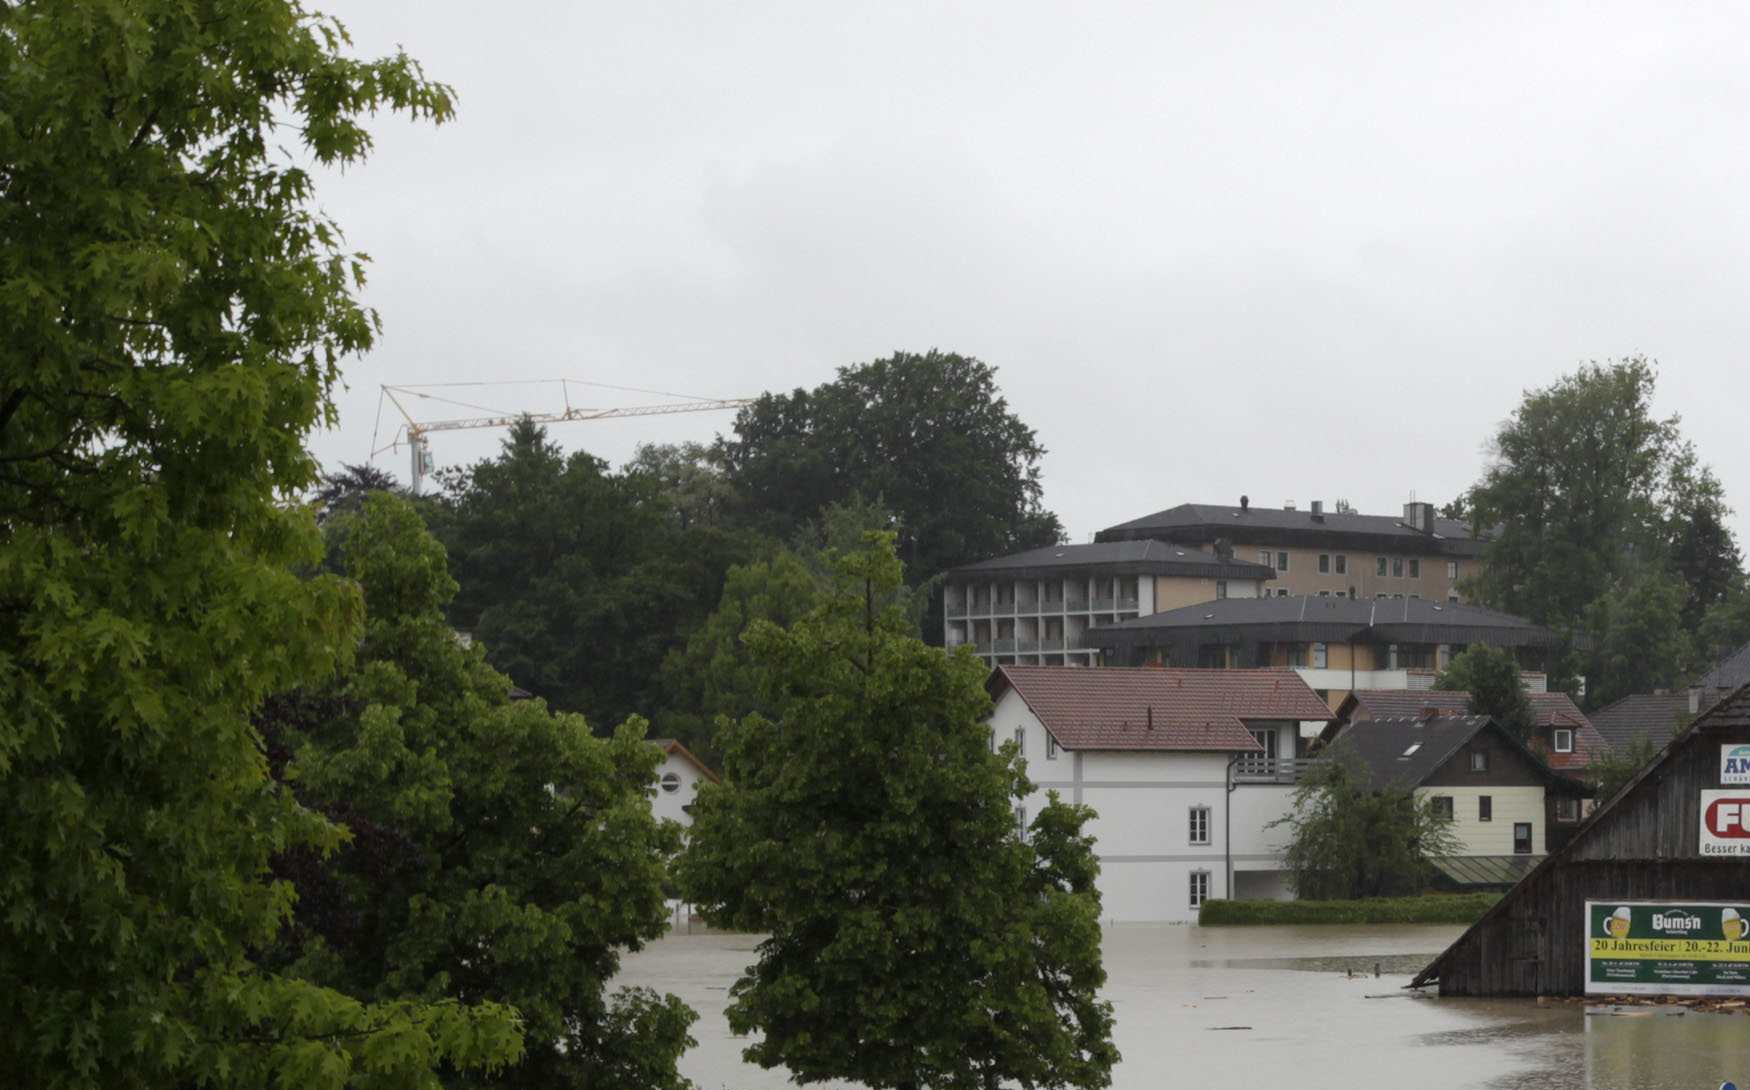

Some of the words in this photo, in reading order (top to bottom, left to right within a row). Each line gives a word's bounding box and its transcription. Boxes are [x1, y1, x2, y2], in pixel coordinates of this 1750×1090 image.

[1704, 843, 1737, 854] Besser
[1594, 940, 1608, 951] 20
[1610, 940, 1675, 952] Jahresfeier
